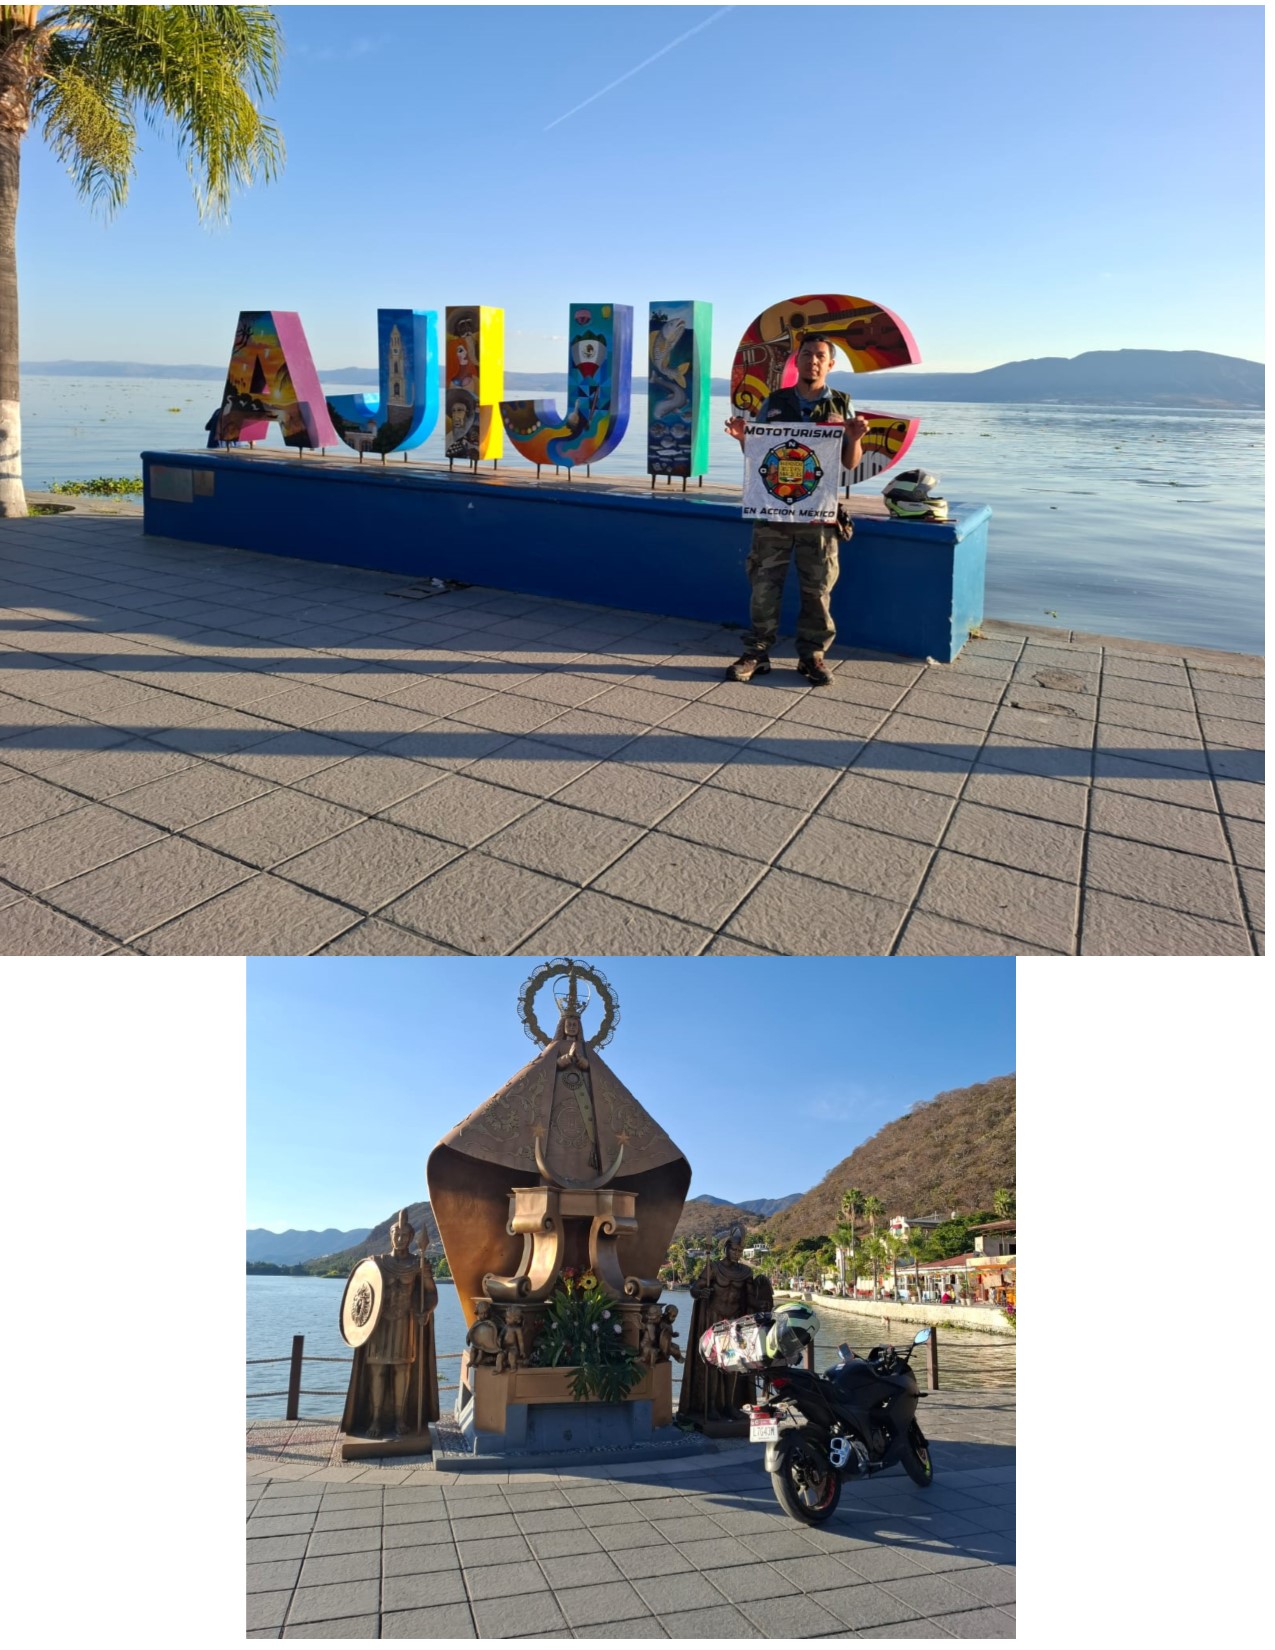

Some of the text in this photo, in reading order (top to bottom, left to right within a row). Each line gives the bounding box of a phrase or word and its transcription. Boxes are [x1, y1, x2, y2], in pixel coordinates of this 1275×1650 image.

[215, 294, 921, 489] AJIJIC
[744, 426, 842, 438] MOTOTURISMO
[760, 506, 796, 516] ACCIÓN
[798, 507, 835, 517] MÉXICO
